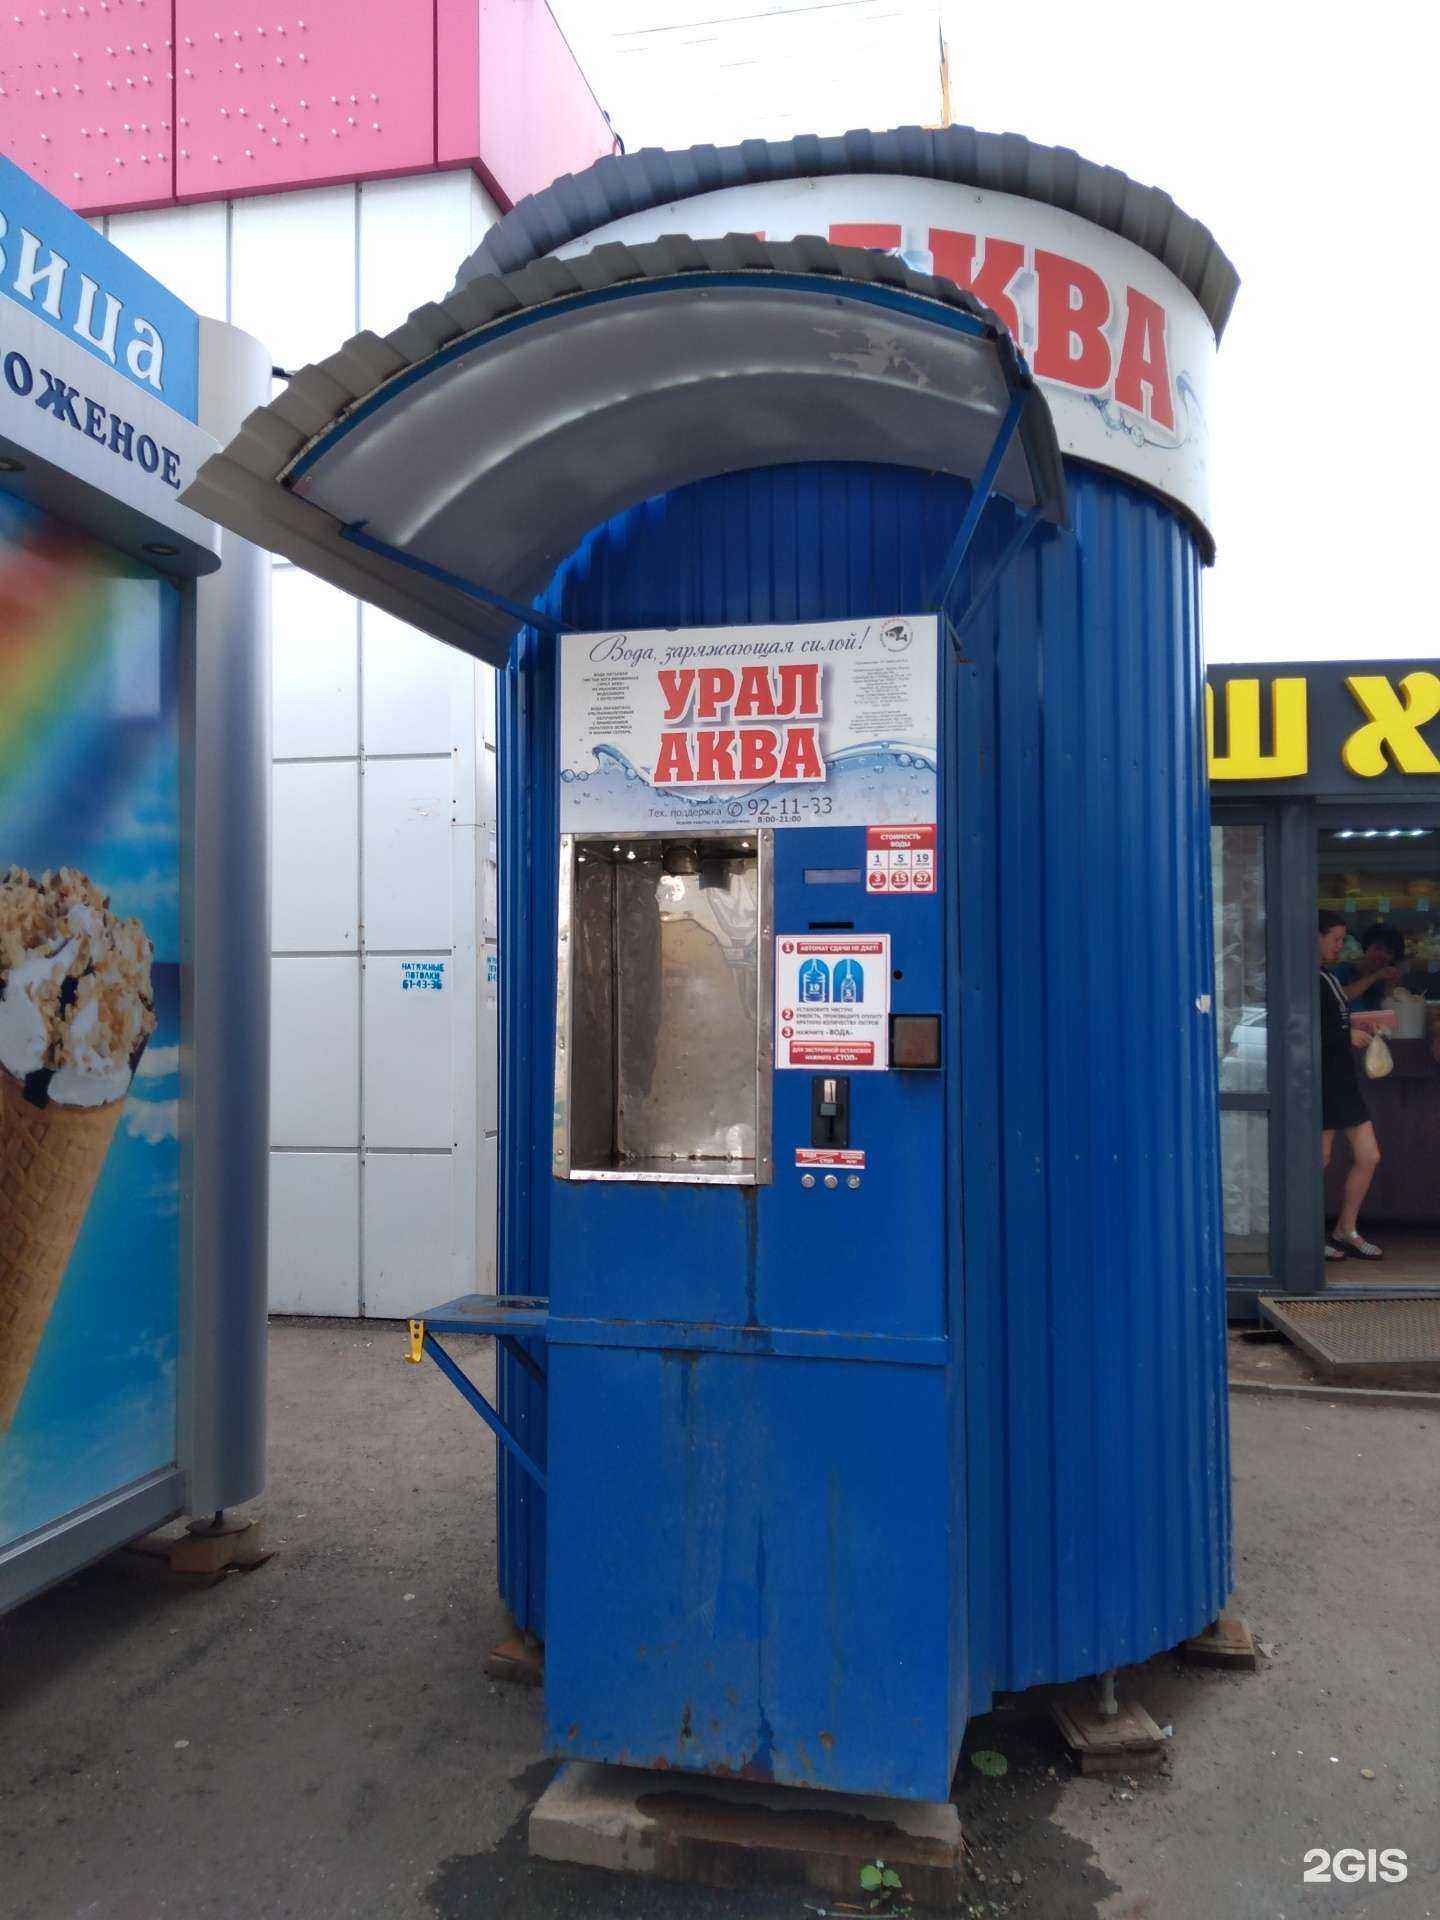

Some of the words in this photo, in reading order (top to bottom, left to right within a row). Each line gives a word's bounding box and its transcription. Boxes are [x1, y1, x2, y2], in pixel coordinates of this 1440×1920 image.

[0, 209, 164, 391] ица
[589, 634, 657, 667] Вода,
[659, 638, 794, 665] заряжающая
[800, 624, 871, 653] силой!
[656, 662, 824, 721] УРАЛ
[653, 727, 826, 783] АКВА
[670, 808, 722, 819] поддержка
[748, 797, 833, 816] 92-11-33
[897, 854, 904, 863] 5
[916, 853, 929, 863] 19
